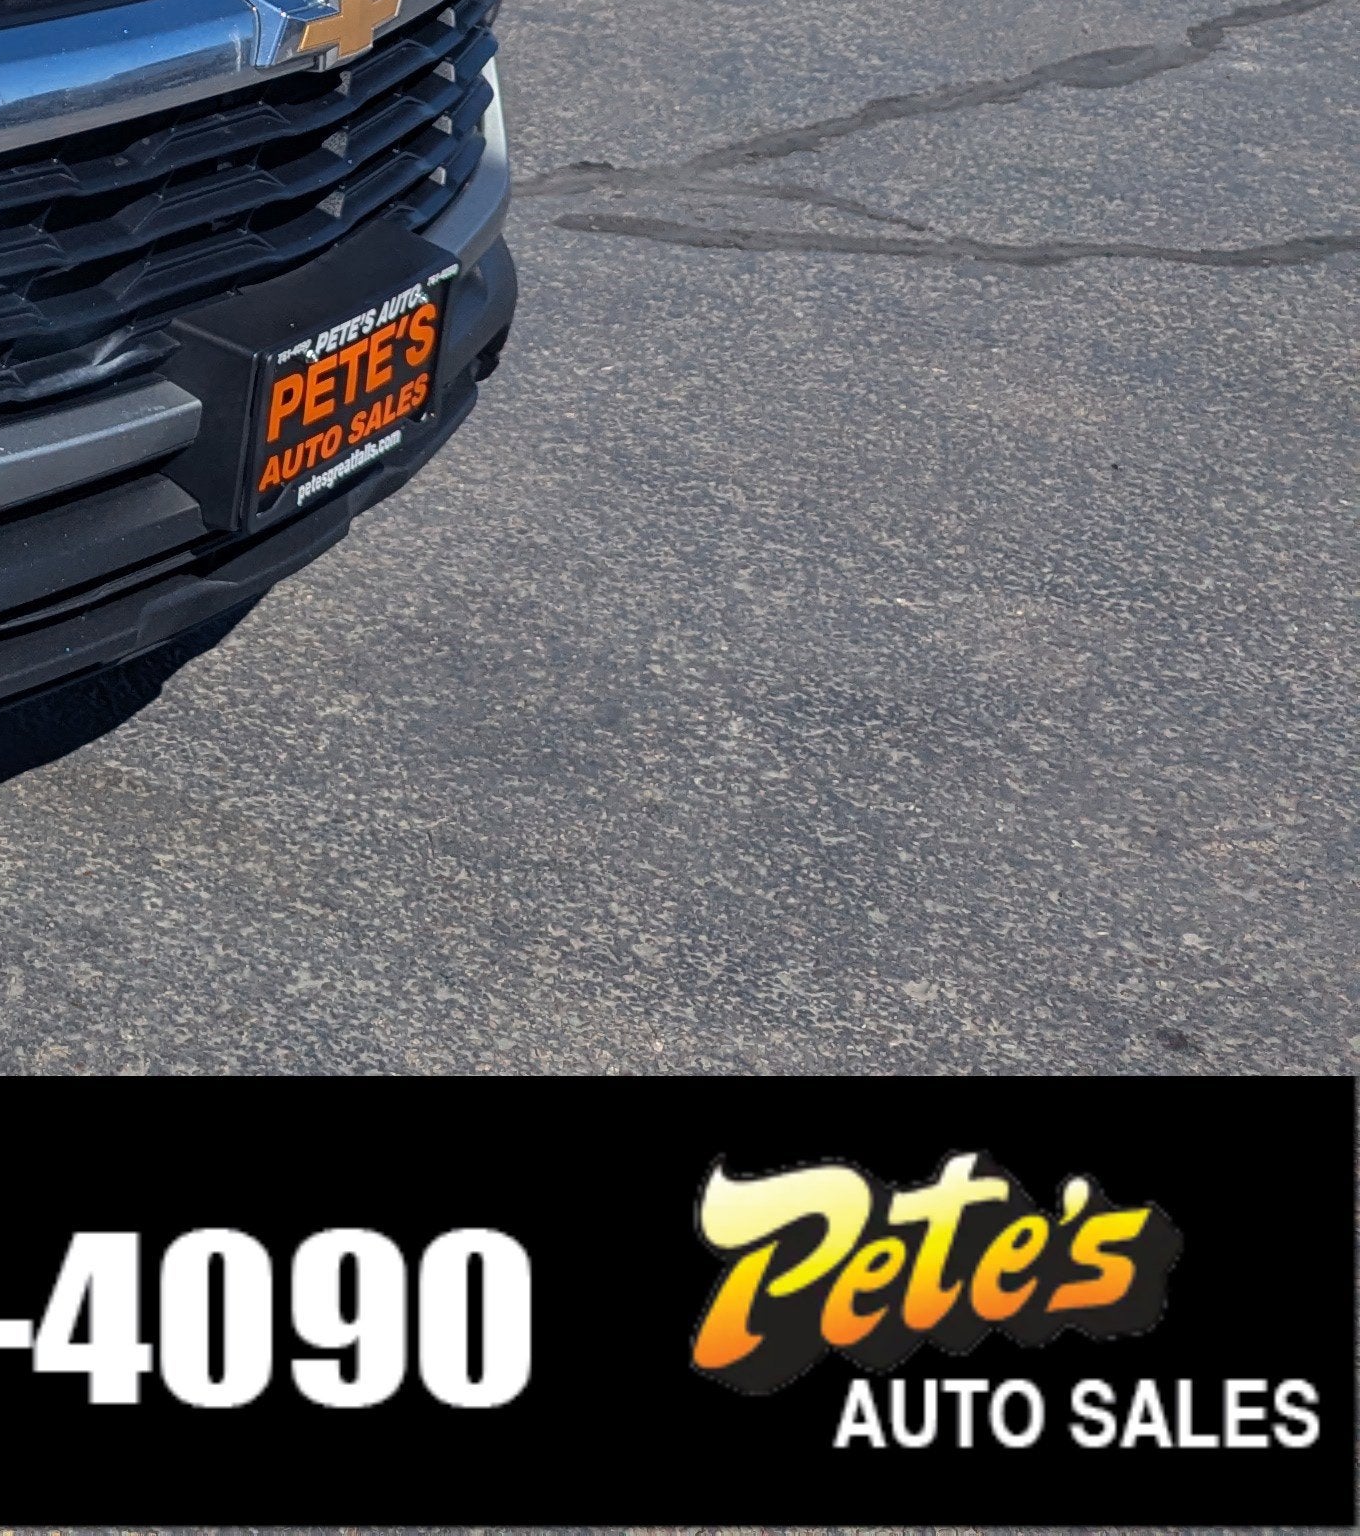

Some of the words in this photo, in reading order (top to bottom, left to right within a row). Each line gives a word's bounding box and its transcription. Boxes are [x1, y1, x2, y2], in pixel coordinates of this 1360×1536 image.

[316, 308, 377, 354] PETE'S
[376, 283, 423, 327] AUTO
[266, 302, 438, 443] PETE'S
[258, 424, 343, 493] AUTO
[347, 372, 429, 444] SALES
[297, 429, 402, 506] petesgreatfalls.com
